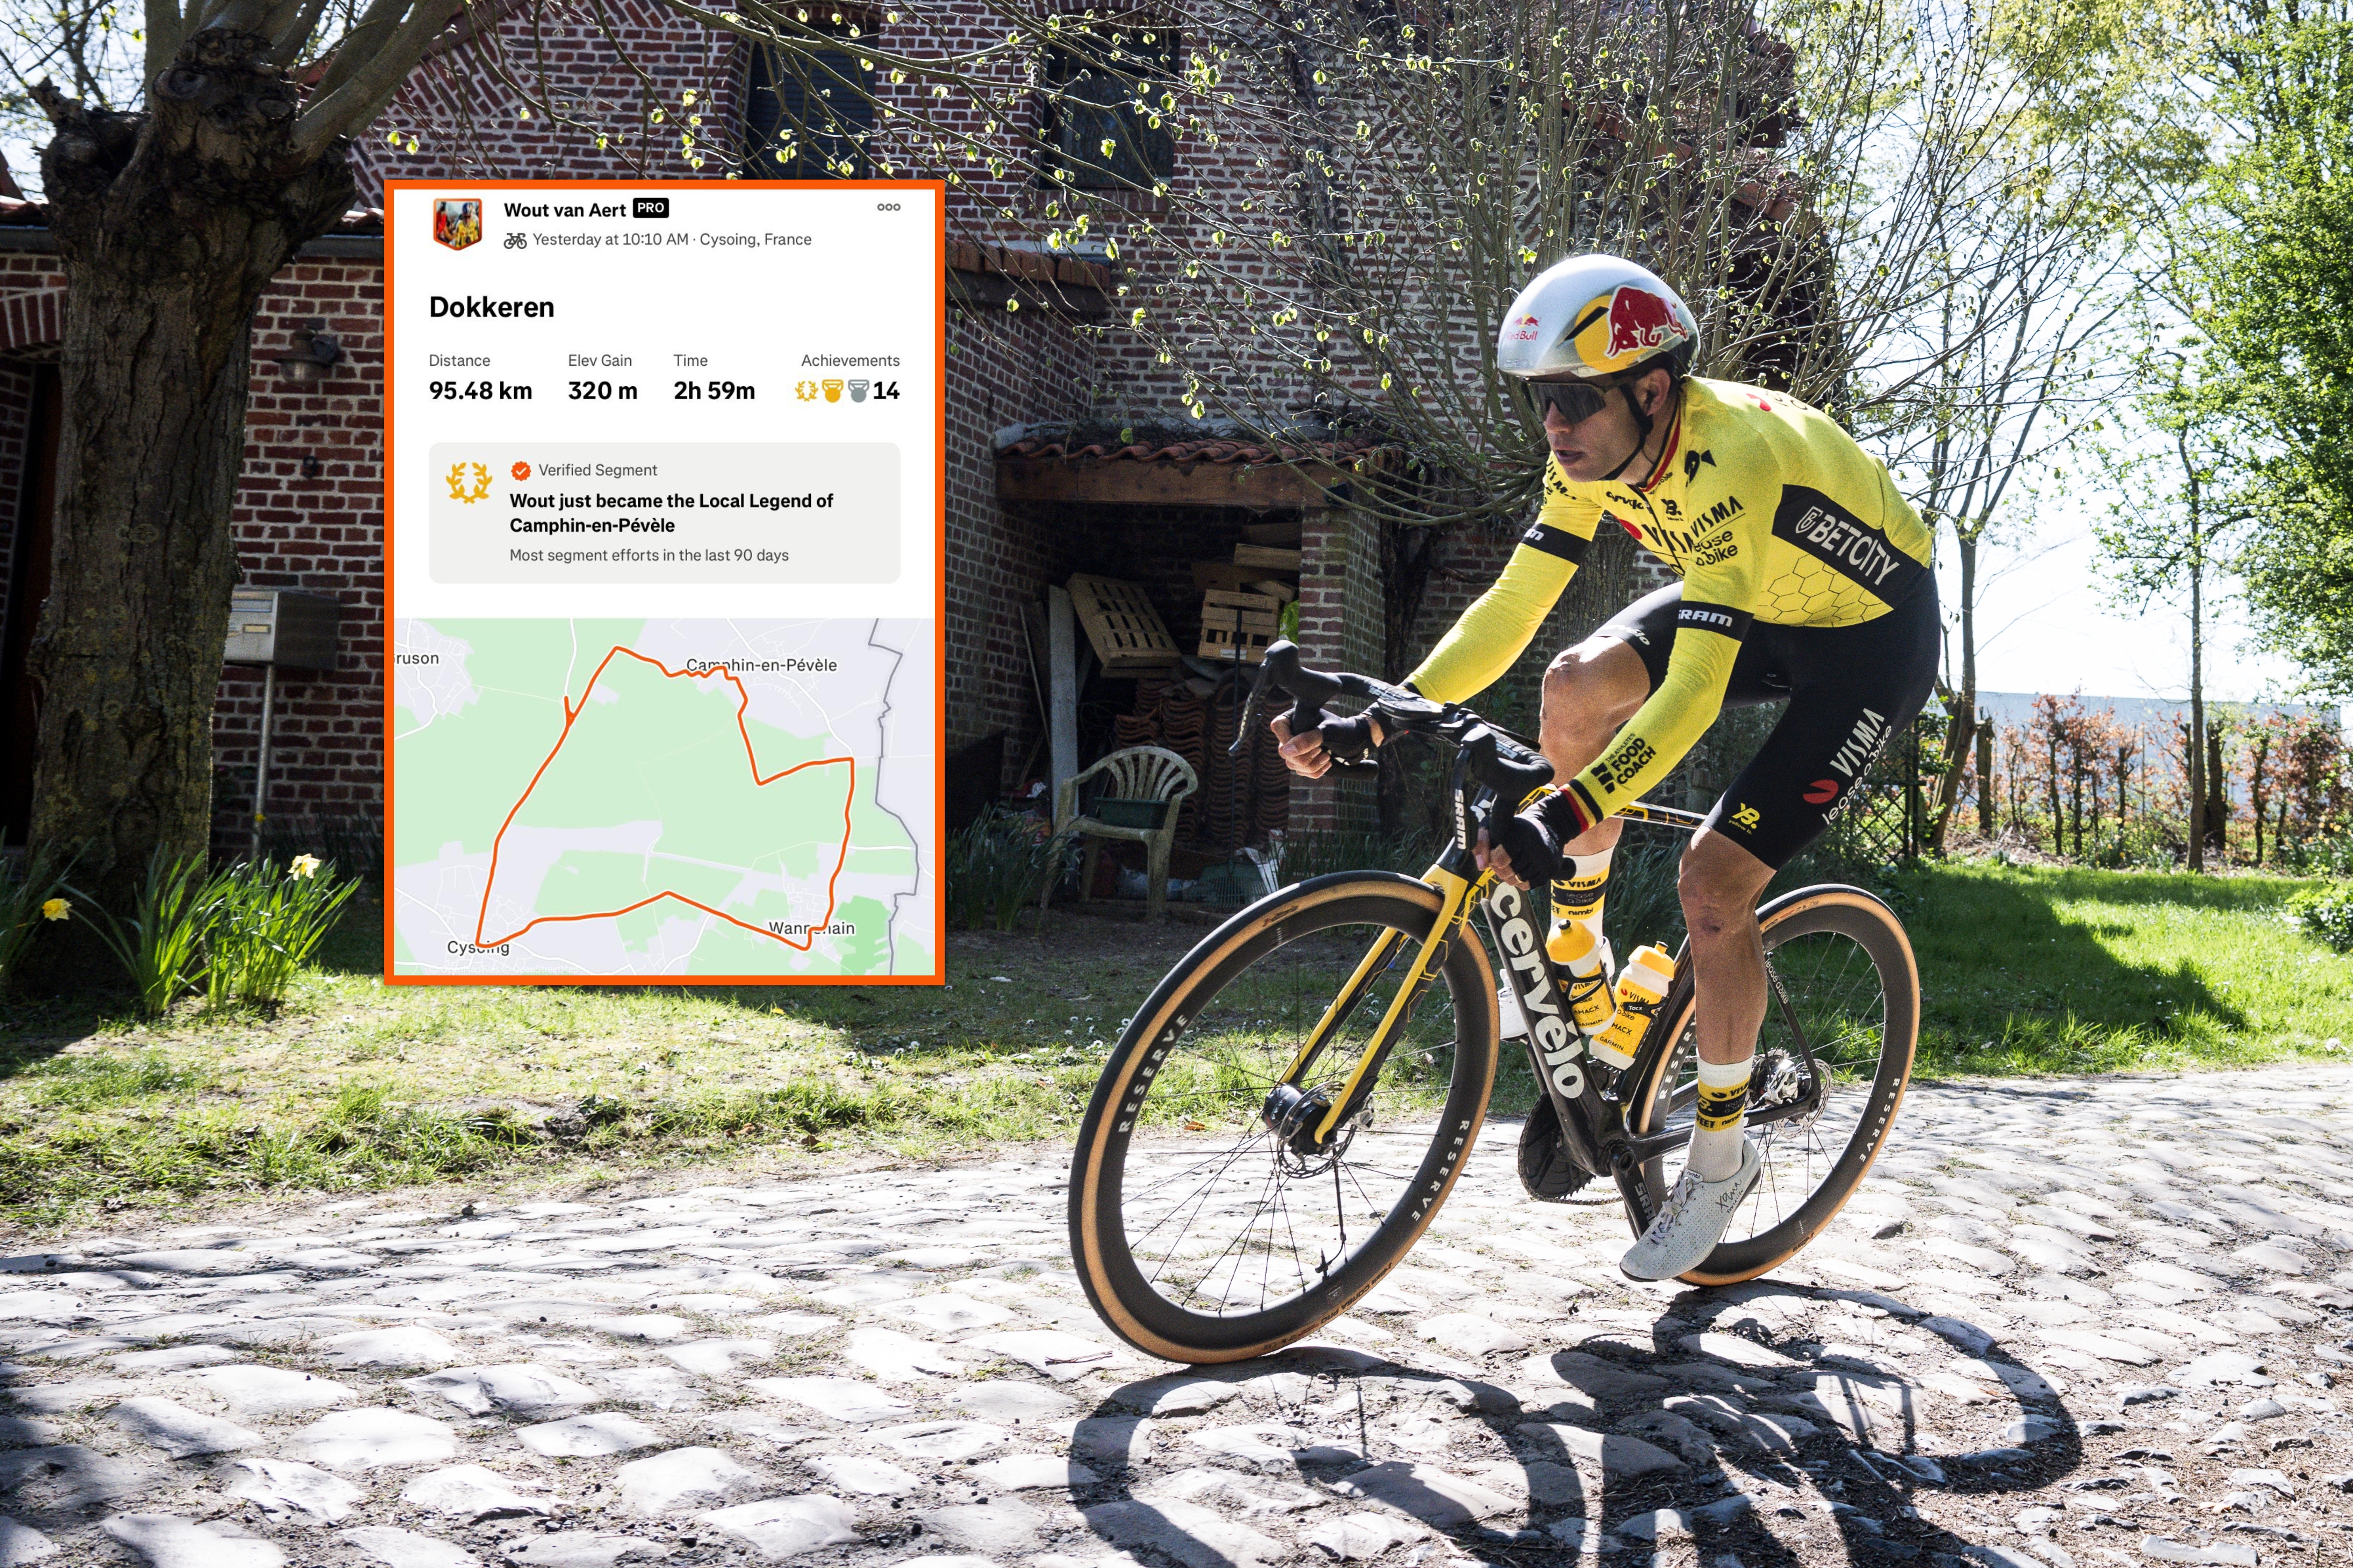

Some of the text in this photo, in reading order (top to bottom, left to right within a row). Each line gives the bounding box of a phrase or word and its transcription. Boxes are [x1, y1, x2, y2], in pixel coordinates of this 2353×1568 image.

[1520, 330, 1538, 340] Bull
[1690, 495, 1744, 538] VISMA
[1693, 530, 1733, 553] ease
[1807, 514, 1901, 586] BETCITY
[1605, 752, 1615, 762] THE
[1610, 737, 1646, 772] FOOD
[1829, 707, 1885, 777] VISMA
[1617, 745, 1657, 785] COACH
[1821, 776, 1863, 825] lease
[1454, 788, 1467, 850] SRAM
[1728, 819, 1747, 831] yellow
[1568, 877, 1602, 888] VISMA
[1568, 907, 1594, 916] nimbl
[1765, 958, 1779, 983] lease
[1573, 1004, 1600, 1015] AMACX
[1599, 1036, 1625, 1051] GARMIN
[1610, 1022, 1632, 1036] MACX
[1118, 1014, 1188, 1133] RESERVE
[1859, 1078, 1901, 1163] RESERVE
[1411, 1120, 1471, 1222] RESERVE
[1686, 1170, 1701, 1180] nimbl
[1634, 1182, 1657, 1225] SRA
